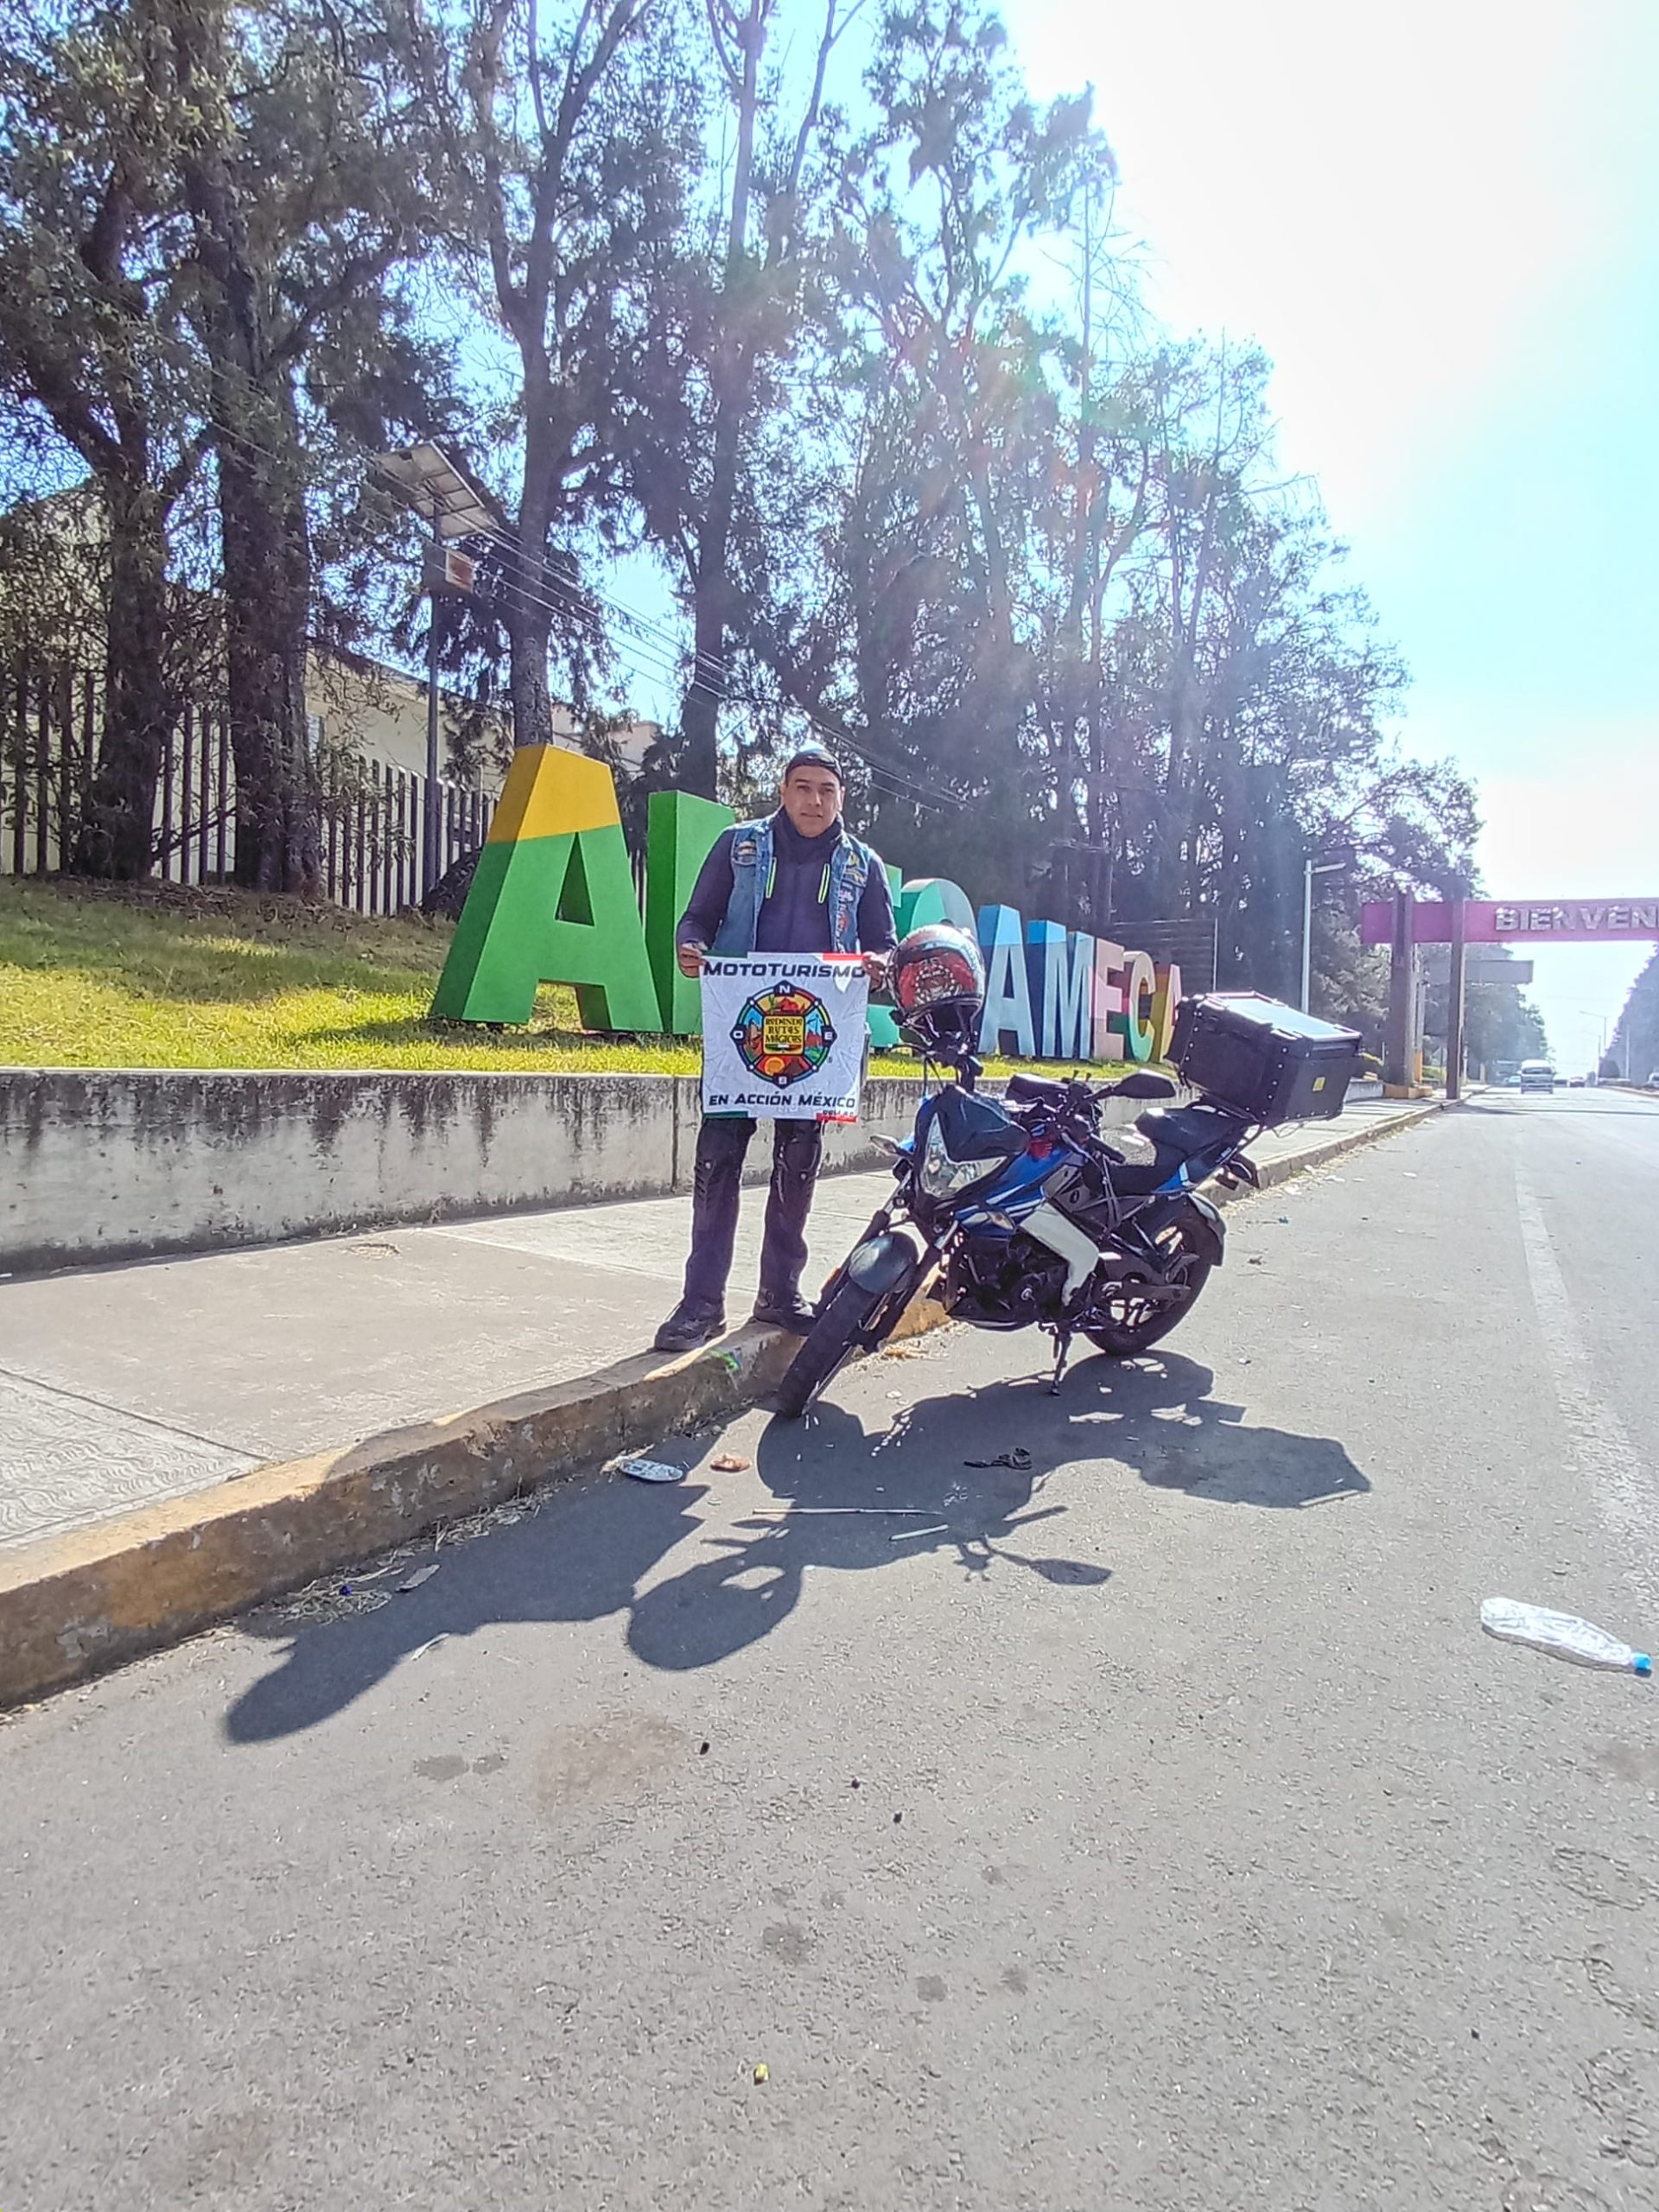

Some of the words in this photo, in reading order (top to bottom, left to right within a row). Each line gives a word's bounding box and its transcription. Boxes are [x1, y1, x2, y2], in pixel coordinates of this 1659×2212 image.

[430, 745, 1184, 1064] AAMECA
[779, 985, 791, 994] N
[709, 1095, 728, 1106] EN
[734, 1090, 792, 1106] ACCIÓN
[798, 1091, 855, 1109] MÉXICO
